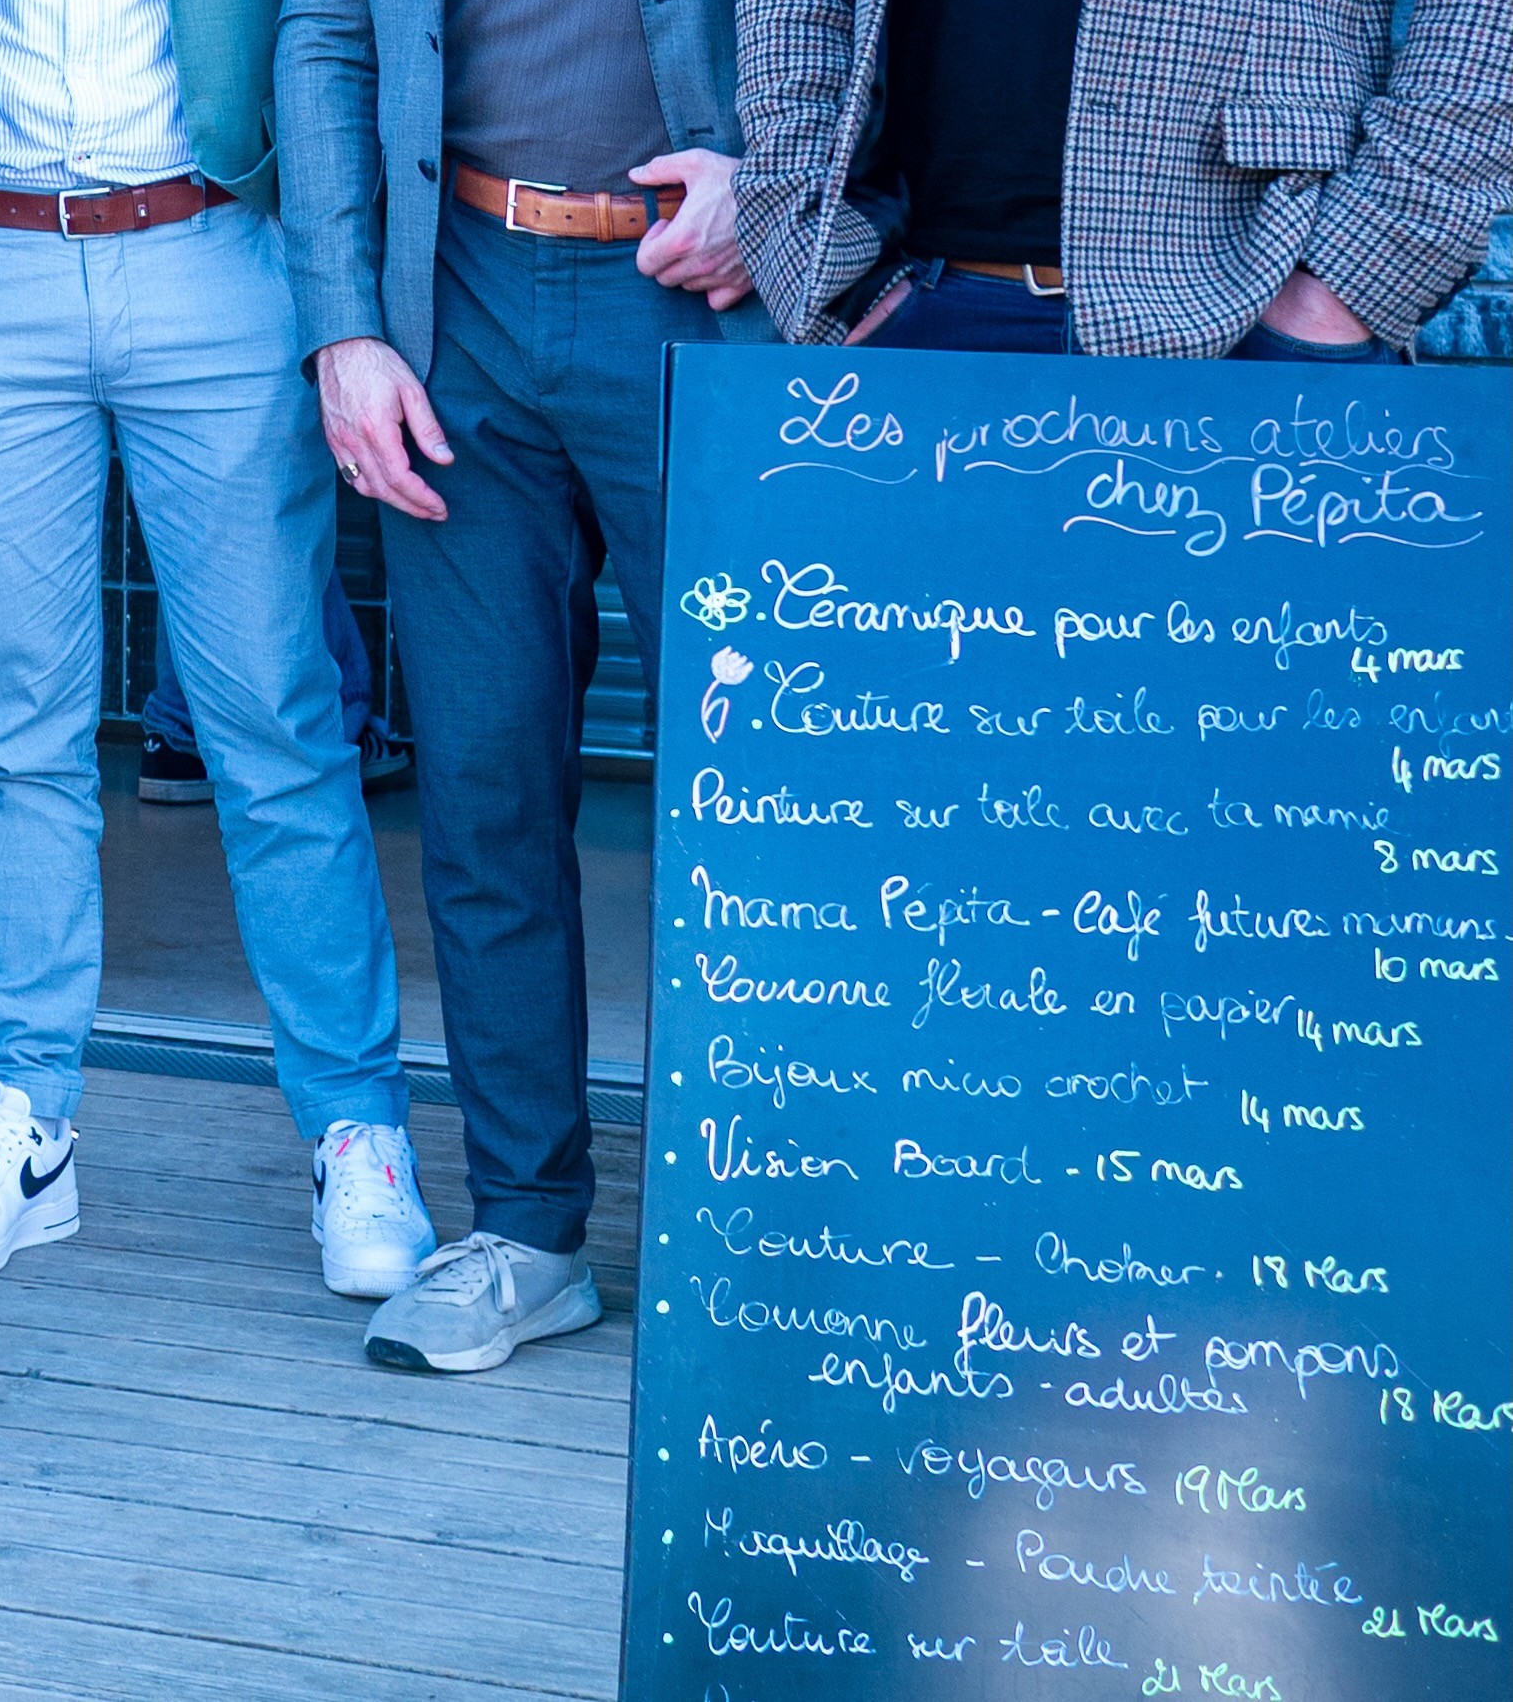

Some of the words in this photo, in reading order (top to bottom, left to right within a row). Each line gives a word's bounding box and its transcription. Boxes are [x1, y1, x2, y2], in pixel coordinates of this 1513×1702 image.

[779, 372, 904, 452] Les
[935, 394, 1223, 483] prochains
[1250, 394, 1454, 470] ateliers
[1086, 458, 1227, 557] chez
[1251, 462, 1483, 548] Pépita
[1054, 606, 1156, 659] pour
[1167, 600, 1217, 645] les
[1231, 600, 1388, 671] enfants
[1351, 646, 1382, 683] 4
[1387, 646, 1464, 672] mars
[763, 659, 951, 736] Couture
[968, 703, 1052, 736] sur
[1064, 686, 1174, 735] toile
[1197, 703, 1288, 742] pour
[1302, 688, 1362, 732] les
[691, 767, 874, 828] Peinture
[895, 799, 960, 828] sur
[977, 782, 1070, 829] toile
[1088, 802, 1189, 836] avec
[1207, 787, 1263, 829] ta
[1274, 802, 1407, 837] mamie
[1391, 745, 1413, 793] 4
[1423, 752, 1501, 781] mars
[1374, 839, 1399, 874] 8
[1412, 846, 1500, 875] mars
[690, 865, 858, 931] Mama
[879, 875, 1030, 947] Pépita
[1073, 889, 1169, 962] Café
[695, 953, 892, 1007] Couronne
[911, 957, 1067, 1030] florale
[1090, 989, 1136, 1015] en
[1160, 990, 1296, 1041] papier
[1374, 947, 1408, 983] 10
[1419, 956, 1500, 983] mars
[1296, 1007, 1325, 1052] 14
[1332, 1018, 1424, 1048] mars
[707, 1034, 878, 1110] Bijoux
[902, 1058, 1023, 1098] micro
[1044, 1061, 1209, 1106] crochet
[1239, 1089, 1272, 1134] 14
[1283, 1102, 1367, 1132] mars
[699, 1114, 860, 1182] Vision
[893, 1139, 1042, 1185] Board
[1095, 1150, 1142, 1183] 15
[1150, 1158, 1244, 1192] mars
[695, 1206, 956, 1270] Couture
[1251, 1254, 1290, 1289] 18
[1304, 1255, 1391, 1294] Mars
[689, 1275, 928, 1350] Couronne
[1120, 1313, 1177, 1362] et
[1205, 1334, 1400, 1400] pompons
[807, 1352, 1015, 1414] enfants
[1064, 1374, 1249, 1415] adultes
[1379, 1387, 1416, 1425] 18
[697, 1414, 829, 1473] Apéro
[1016, 1529, 1177, 1594] Poudre
[1192, 1554, 1363, 1605] teintée
[687, 1591, 877, 1656] Couture
[907, 1632, 976, 1662] sur
[1000, 1620, 1130, 1668] toile
[1362, 1605, 1401, 1639] 21
[1417, 1603, 1500, 1643] Mars
[1142, 1659, 1180, 1697] 21
[1200, 1660, 1282, 1702] Mars
